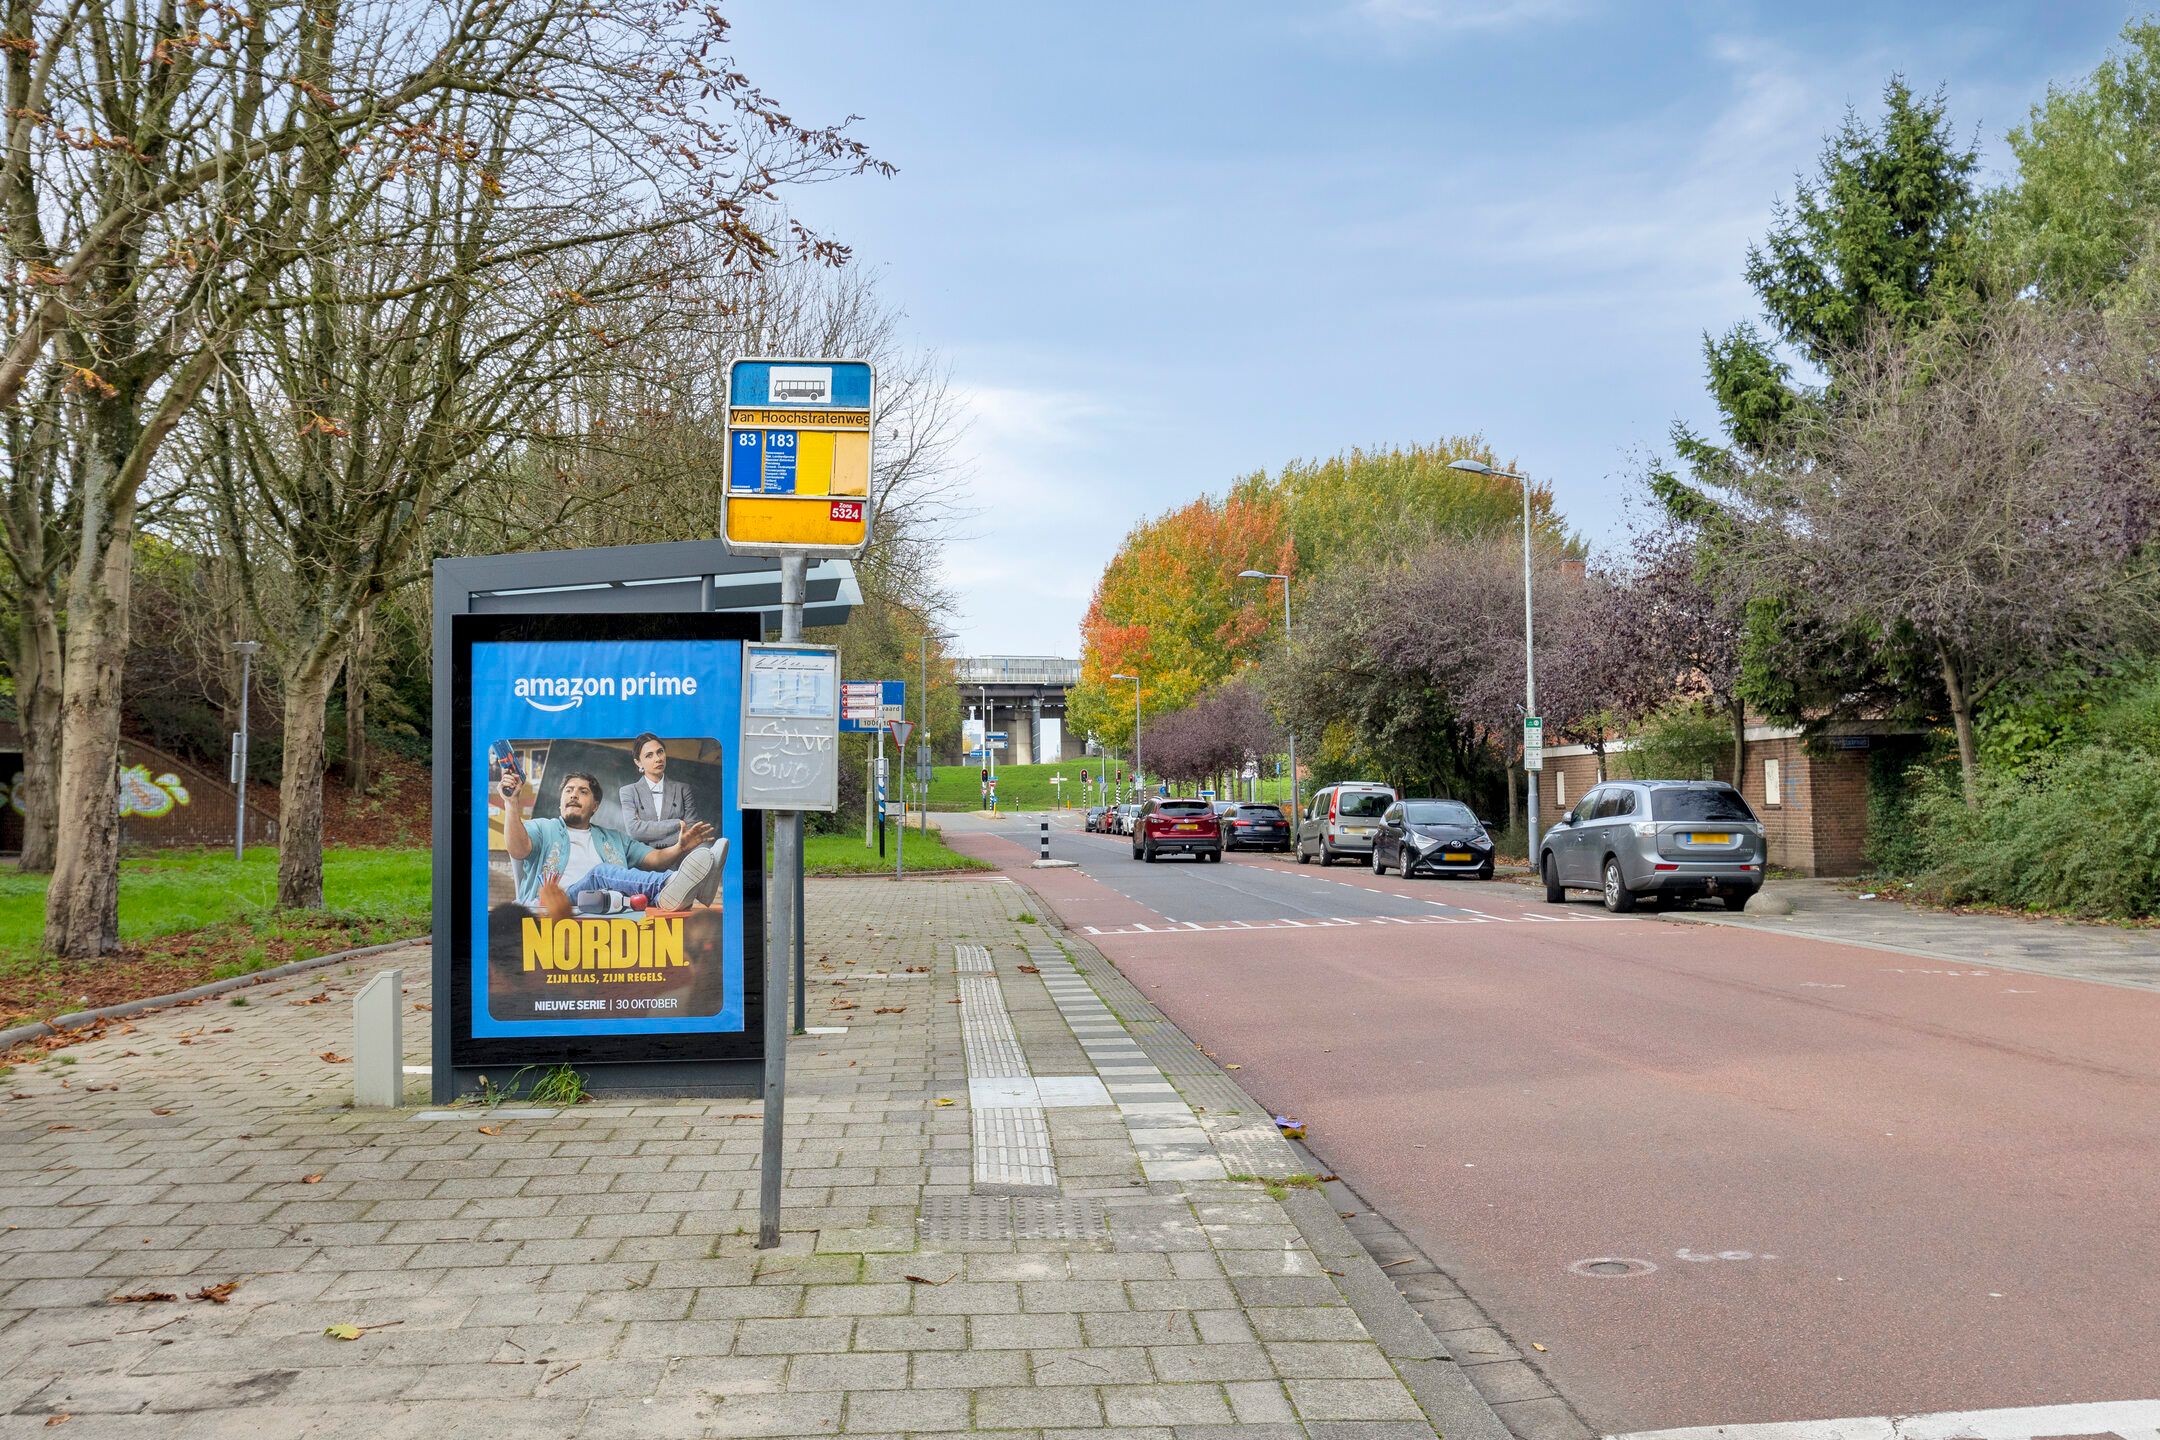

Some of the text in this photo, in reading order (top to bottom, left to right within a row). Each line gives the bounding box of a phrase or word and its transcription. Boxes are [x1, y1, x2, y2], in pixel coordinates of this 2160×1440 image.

[732, 411, 870, 425] Van Hoochstratenweg
[739, 433, 757, 446] 83
[769, 434, 795, 447] 183
[832, 508, 859, 519] 5324
[514, 671, 697, 701] amazon prime
[546, 972, 667, 985] ZIJN KLAS, ZIJN REGELS.
[534, 998, 678, 1011] NIEUWE SERIE 30 OKTOBER
